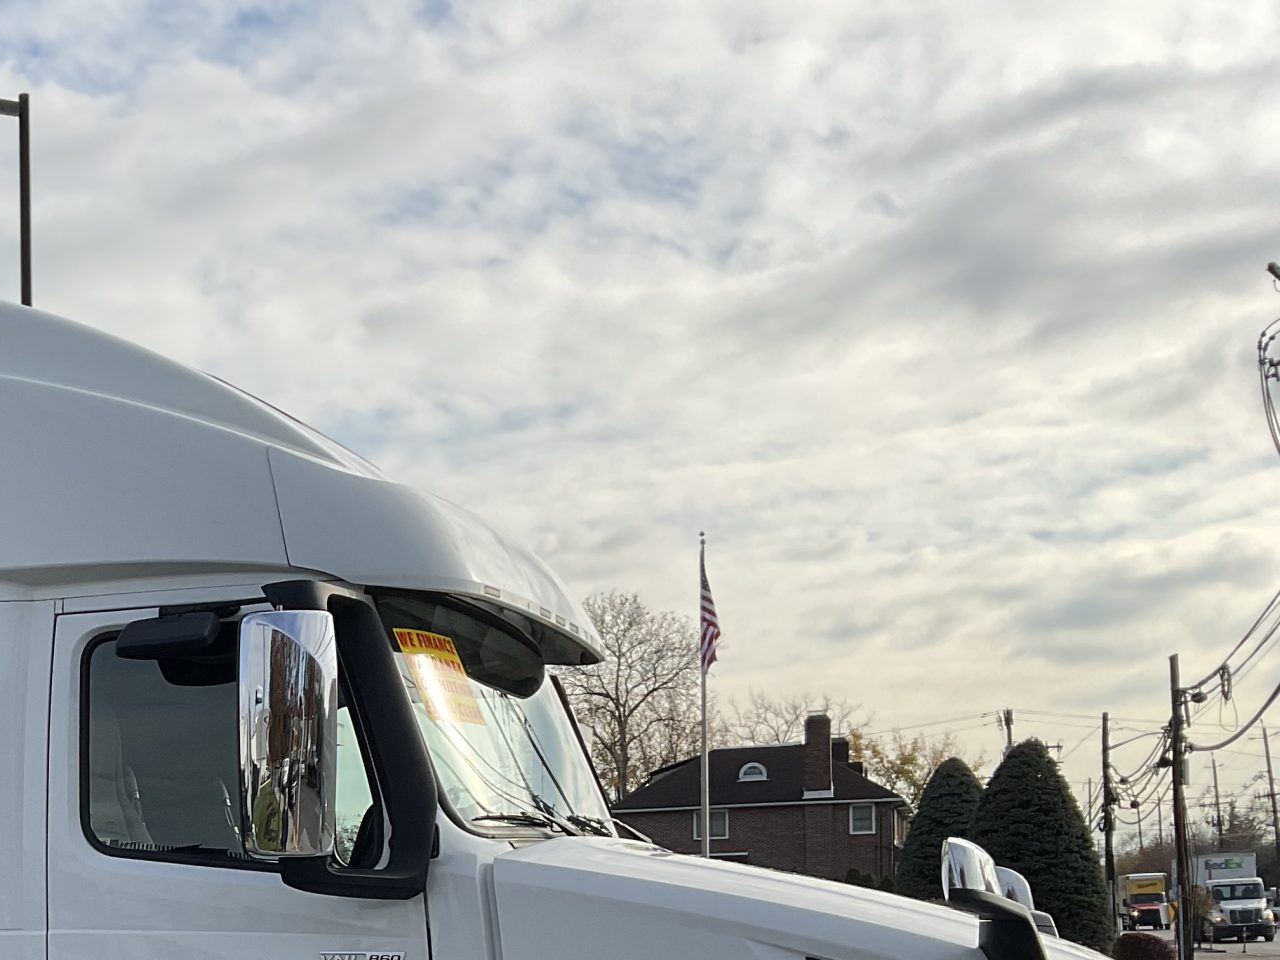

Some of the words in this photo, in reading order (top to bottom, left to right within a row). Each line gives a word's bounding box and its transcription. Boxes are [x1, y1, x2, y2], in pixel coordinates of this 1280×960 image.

[396, 631, 416, 648] WE
[416, 633, 456, 655] FINANCE
[1204, 858, 1243, 869] FedEx
